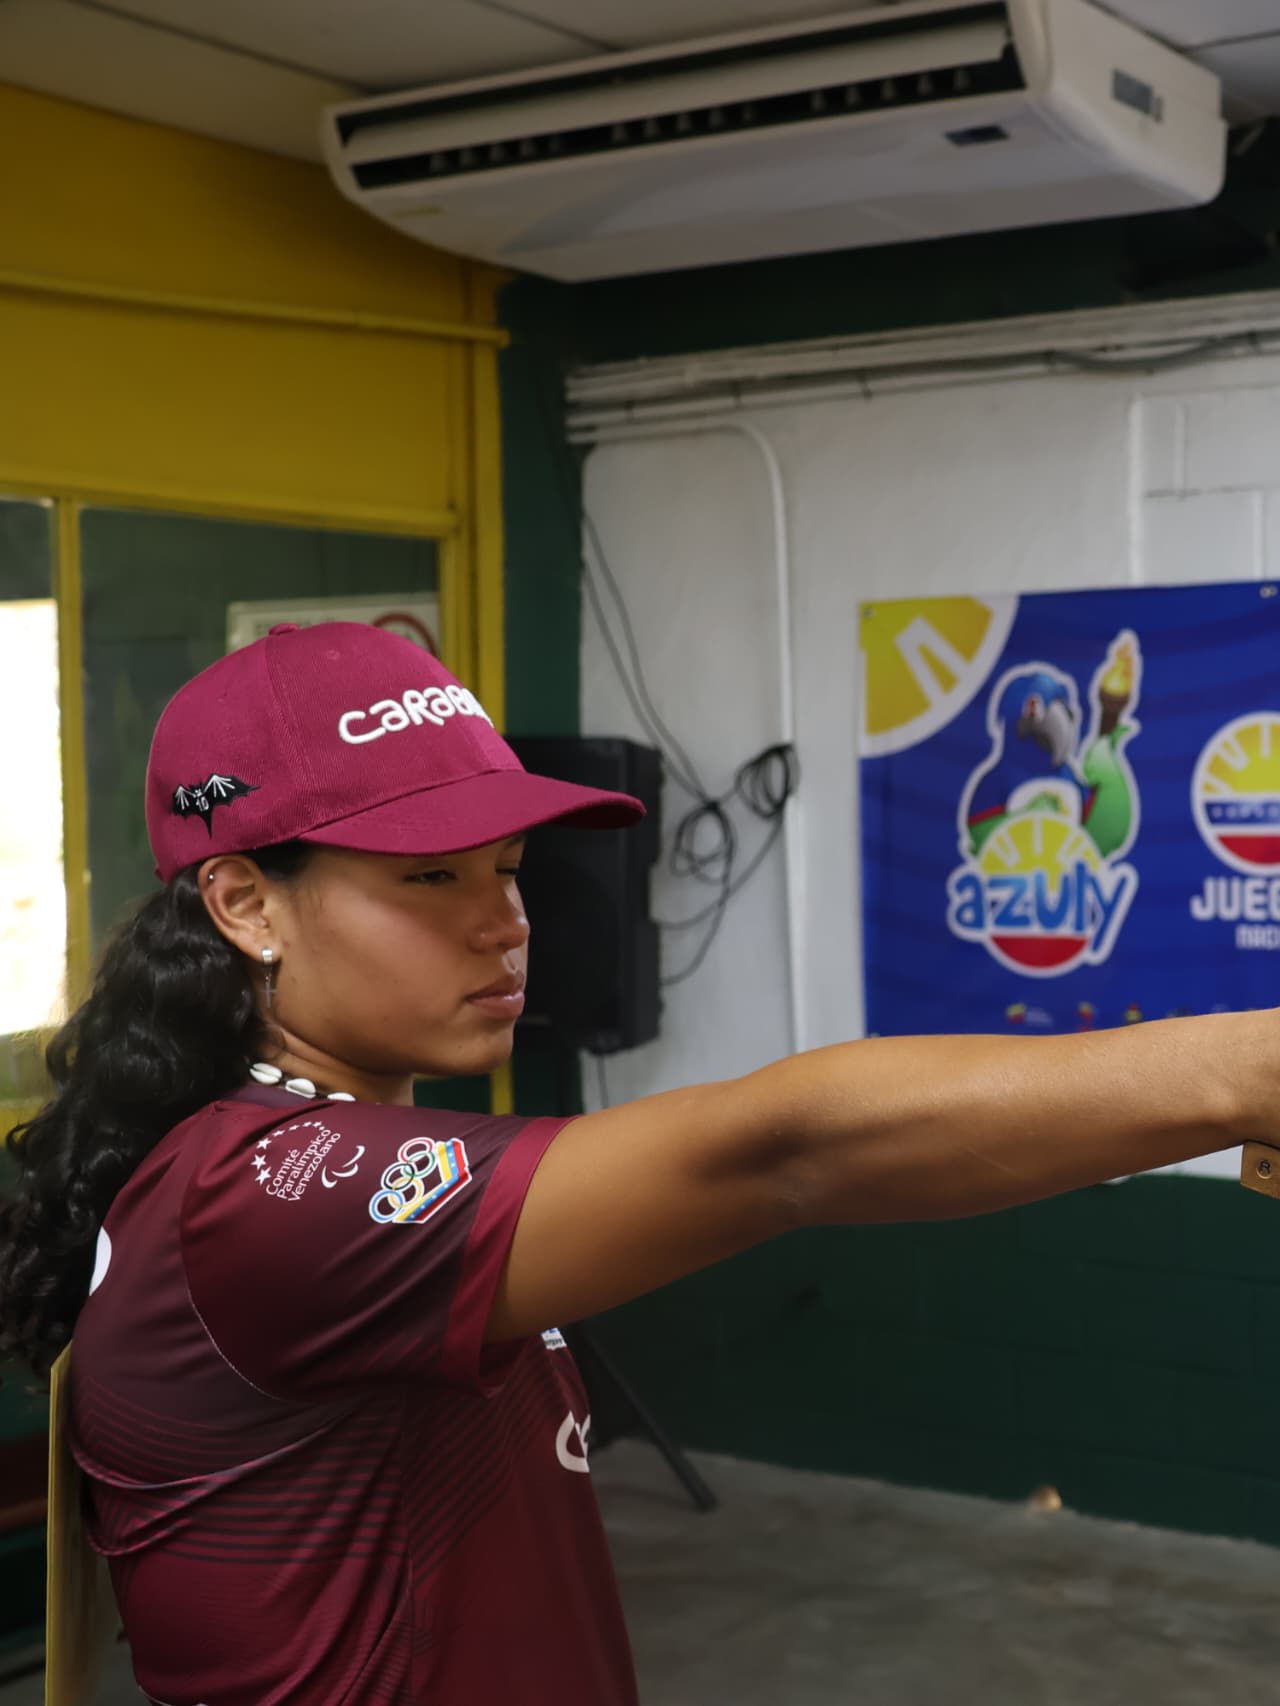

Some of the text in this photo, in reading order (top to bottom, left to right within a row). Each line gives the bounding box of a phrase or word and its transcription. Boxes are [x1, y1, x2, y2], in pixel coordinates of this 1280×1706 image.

[953, 861, 1132, 955] azuly
[265, 1149, 300, 1196] Comité
[287, 1133, 341, 1201] Venezolano
